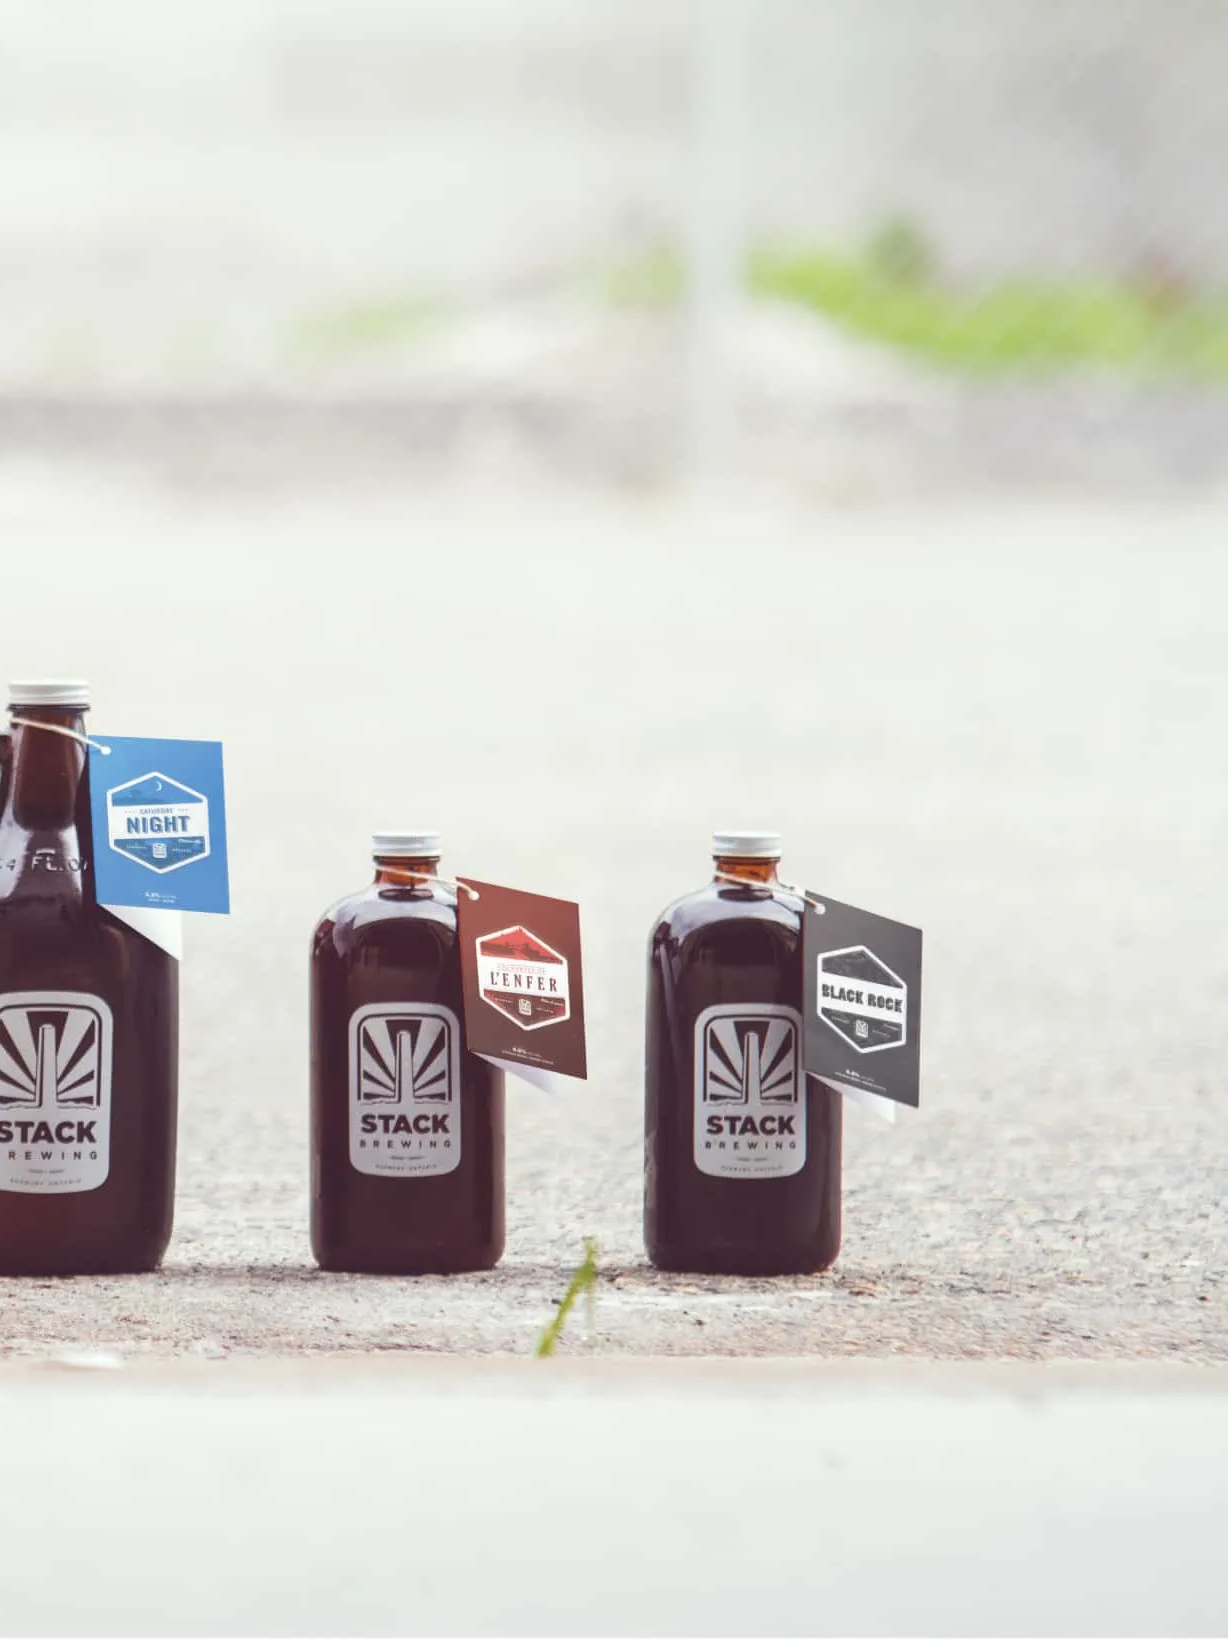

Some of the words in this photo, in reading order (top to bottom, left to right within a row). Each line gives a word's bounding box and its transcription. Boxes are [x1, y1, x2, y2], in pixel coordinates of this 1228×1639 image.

[126, 816, 191, 833] NIGHT
[490, 971, 558, 992] L'ENFER
[821, 983, 864, 1004] BLACK
[867, 992, 903, 1013] ROCK
[361, 1113, 451, 1134] STACK
[706, 1115, 796, 1136] STACK
[359, 1139, 452, 1149] BREWING
[704, 1141, 797, 1150] BREWING
